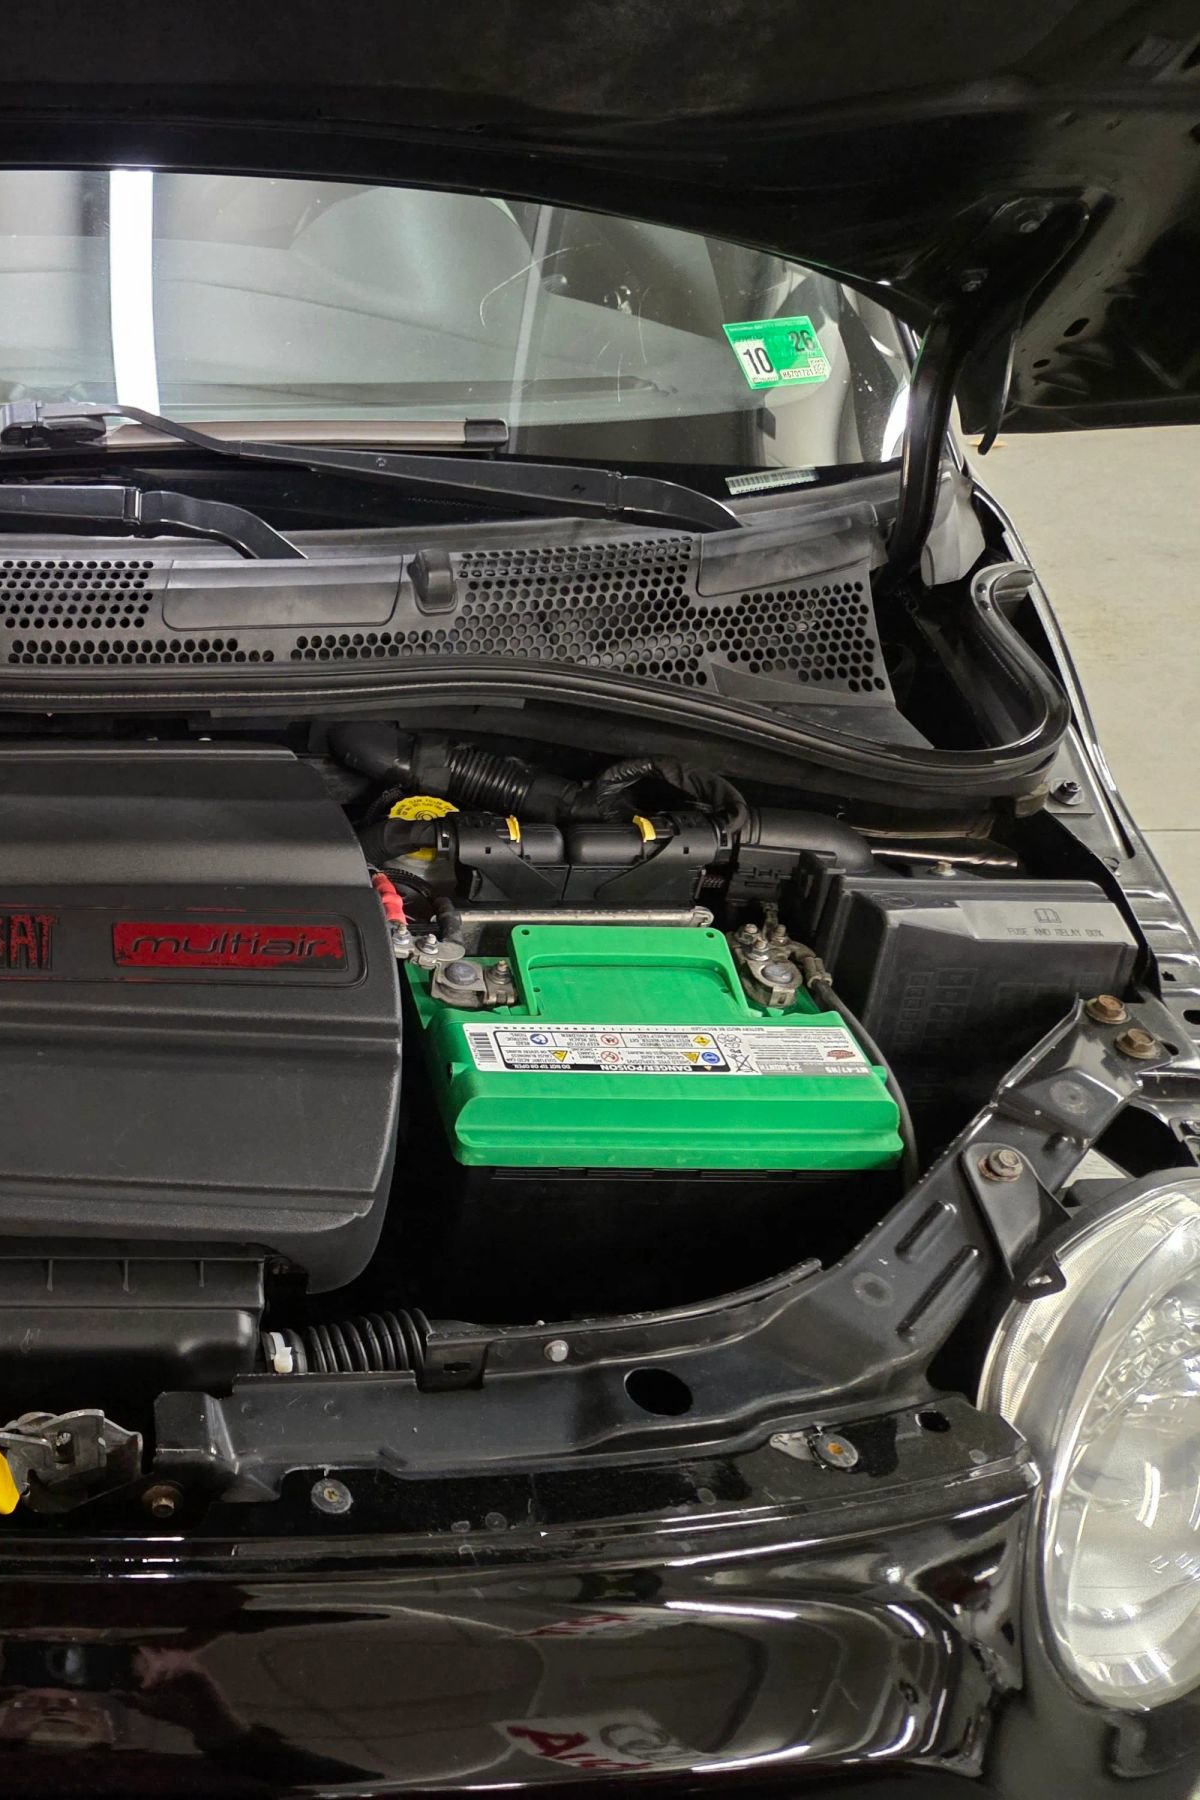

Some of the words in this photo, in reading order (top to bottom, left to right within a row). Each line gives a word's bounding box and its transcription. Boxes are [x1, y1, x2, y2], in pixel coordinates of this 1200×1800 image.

[788, 329, 816, 353] 26
[742, 347, 775, 375] 10
[131, 931, 327, 957] multiair
[600, 1064, 693, 1072] DANGER/POISON
